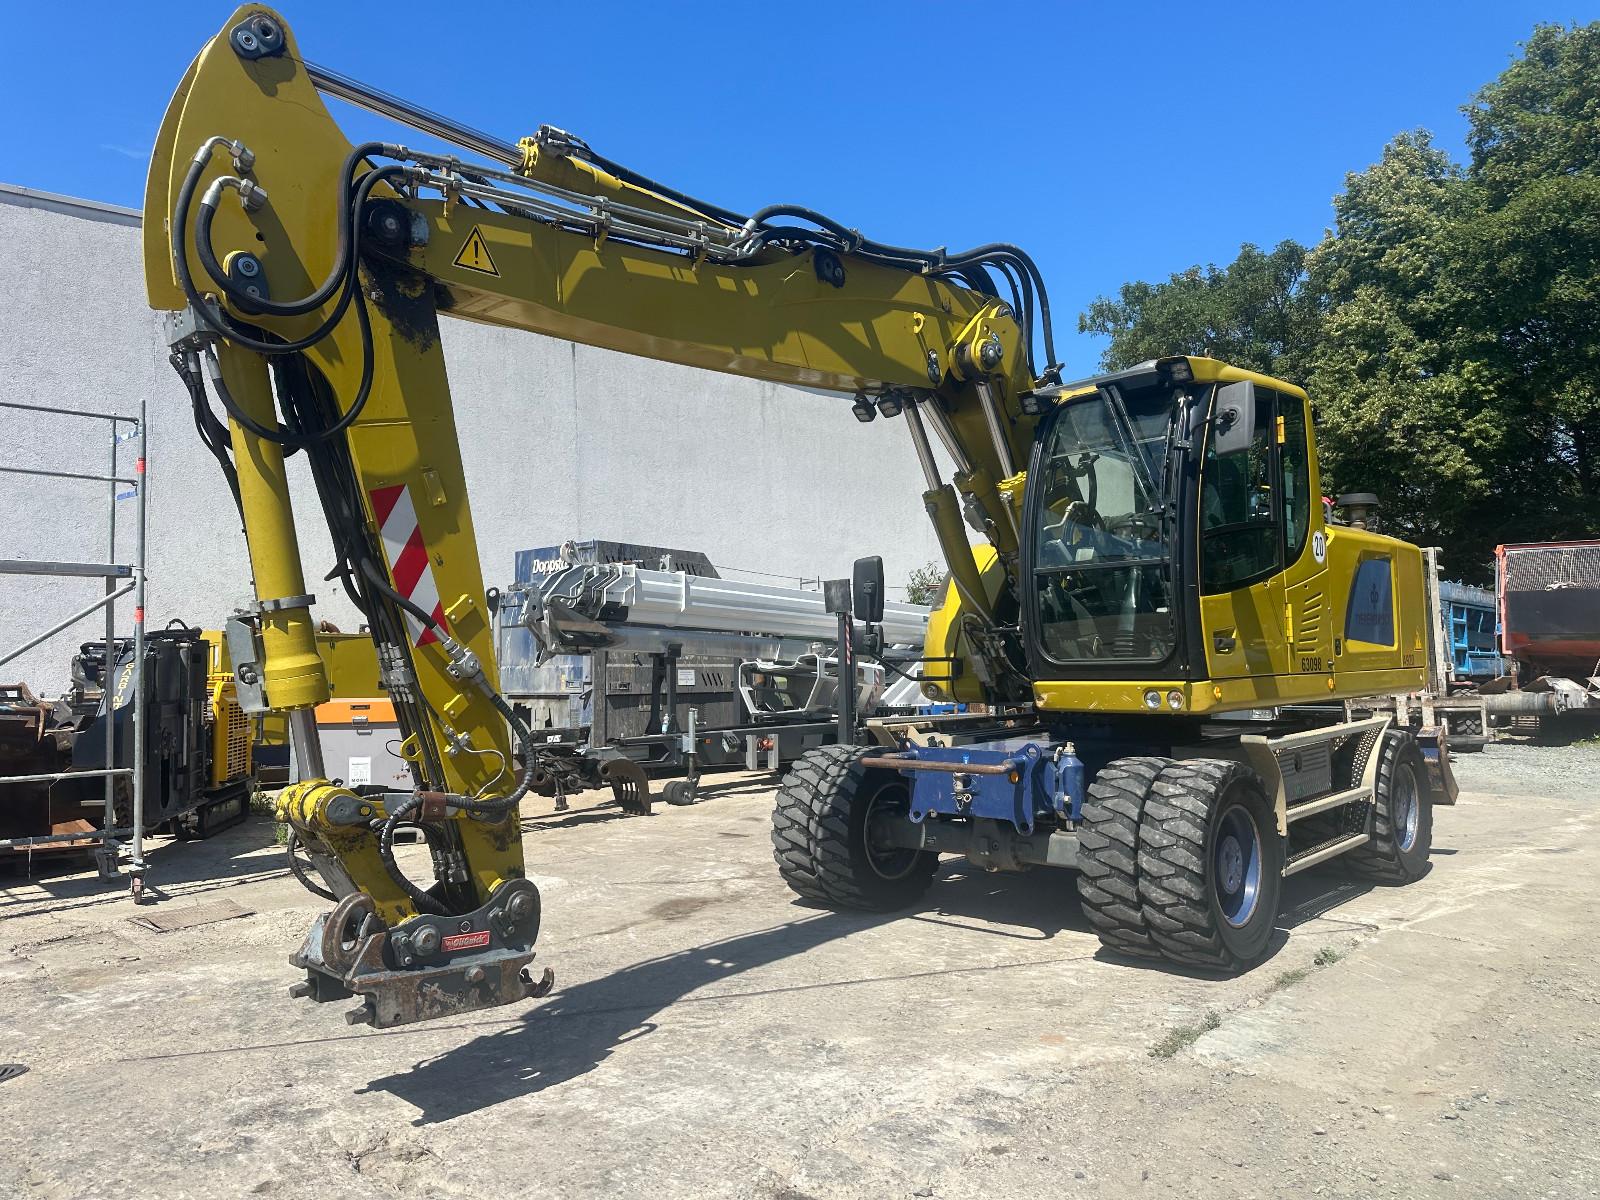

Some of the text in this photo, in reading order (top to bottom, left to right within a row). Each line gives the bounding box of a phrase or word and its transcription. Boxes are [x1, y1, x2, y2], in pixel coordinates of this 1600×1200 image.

[1314, 535, 1324, 557] 20
[532, 558, 570, 577] Doppsta
[1301, 657, 1322, 672] 63098
